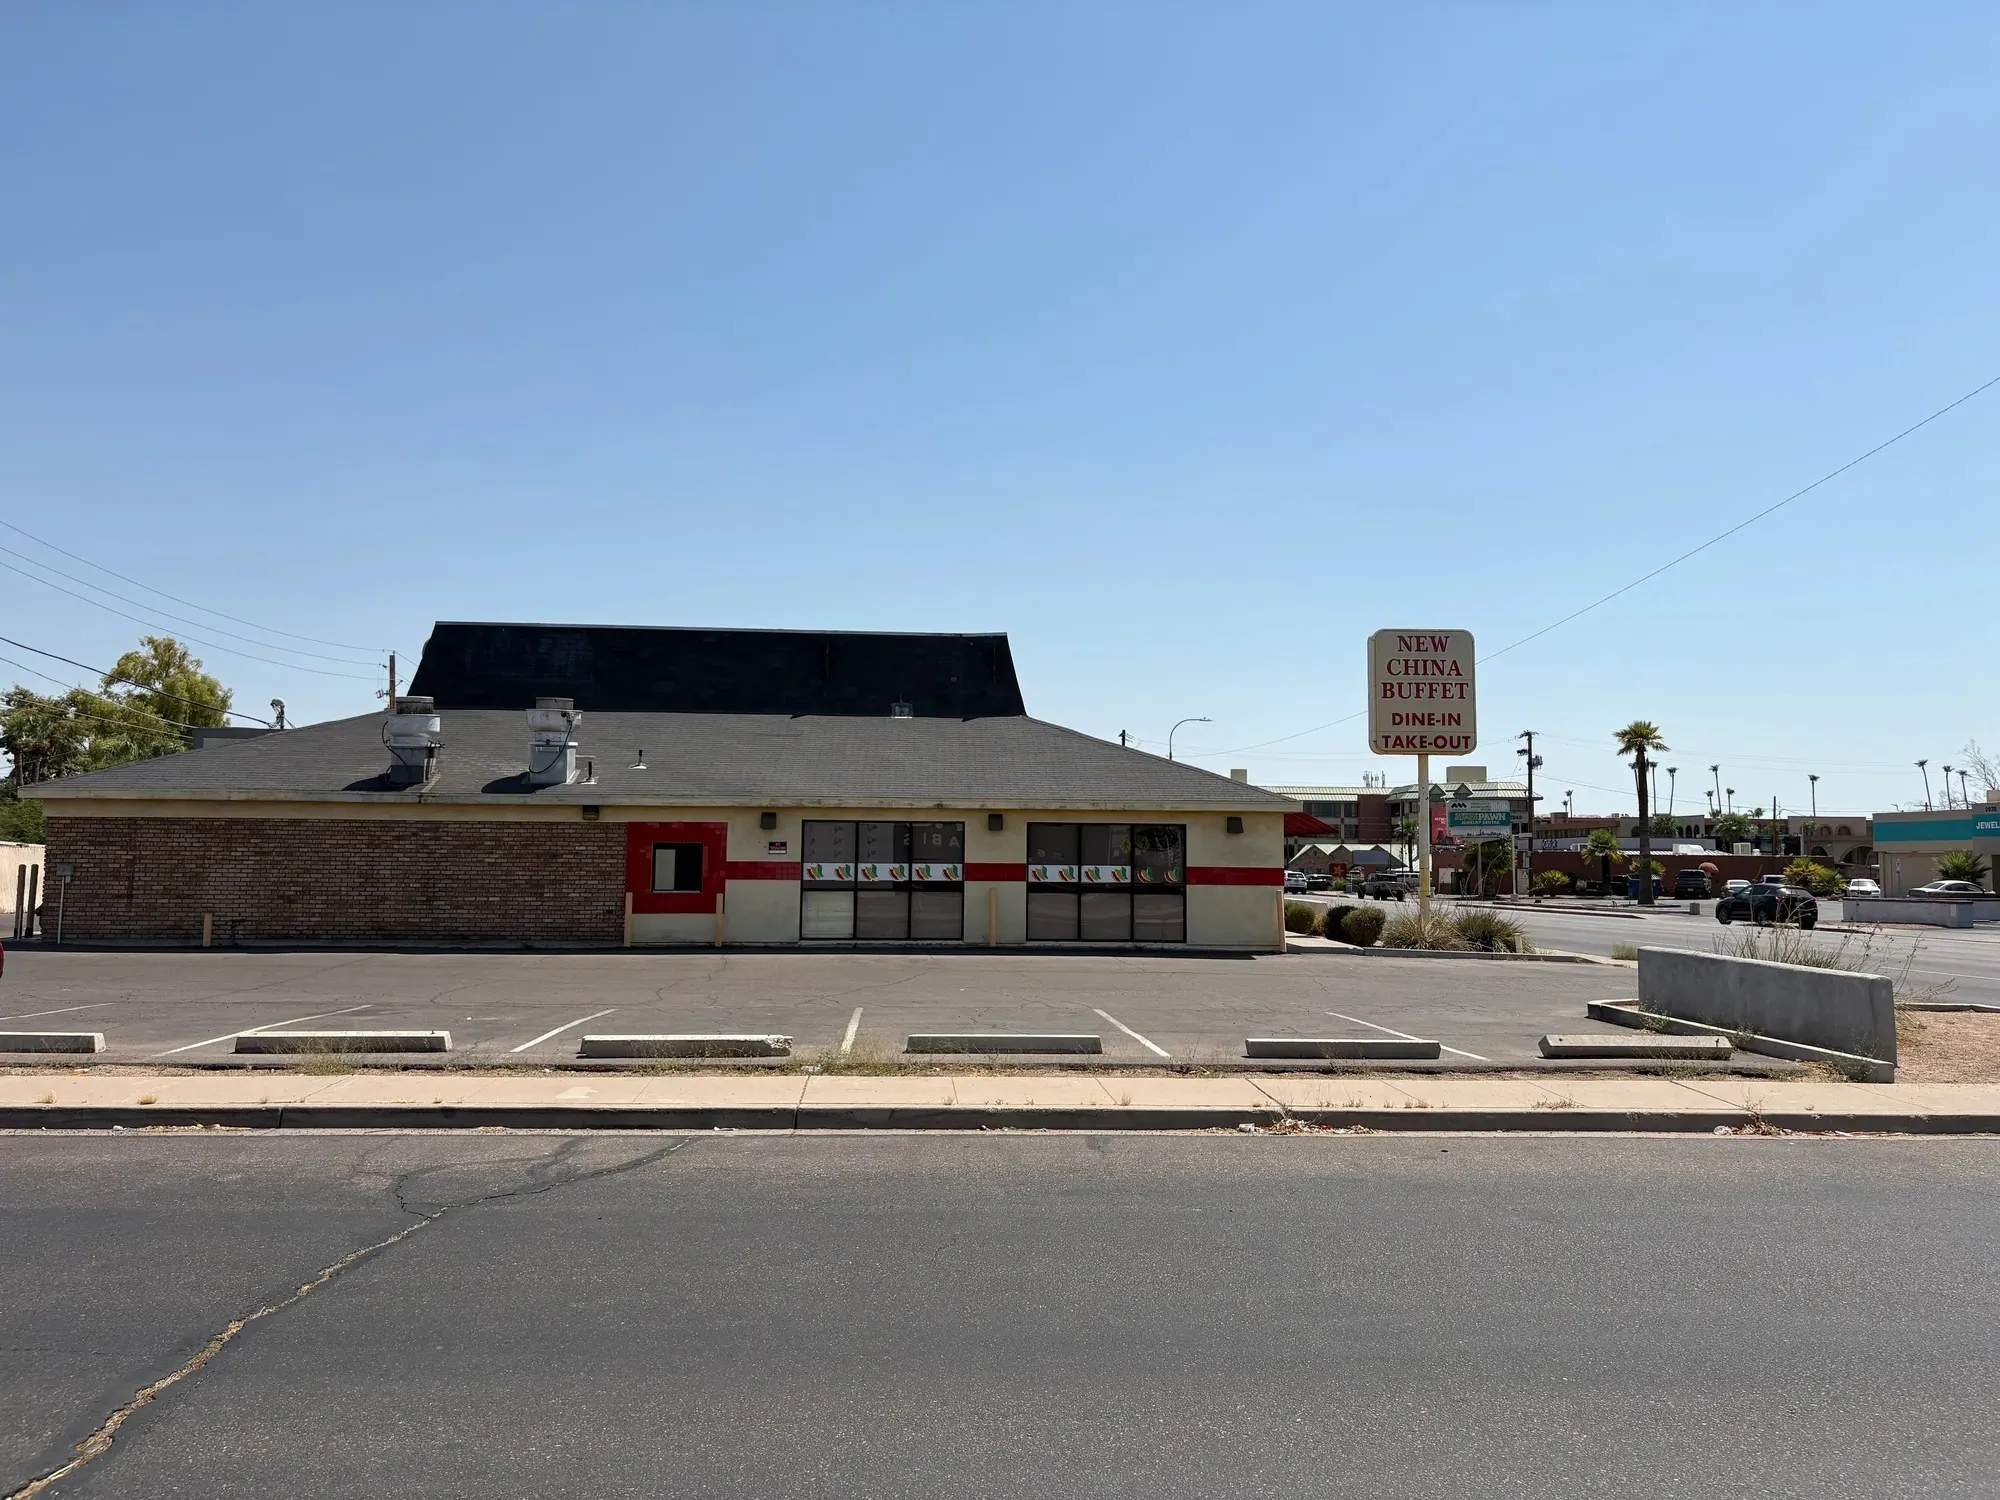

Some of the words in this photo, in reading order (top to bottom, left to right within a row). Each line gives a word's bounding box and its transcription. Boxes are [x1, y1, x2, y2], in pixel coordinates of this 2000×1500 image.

[1397, 636, 1450, 652] NEW
[1386, 659, 1463, 676] CHINA
[1381, 682, 1469, 699] BUFFET
[1391, 712, 1461, 726] DINE-IN
[1382, 735, 1471, 749] TAKE-OUT
[1976, 821, 2000, 829] JEWEL
